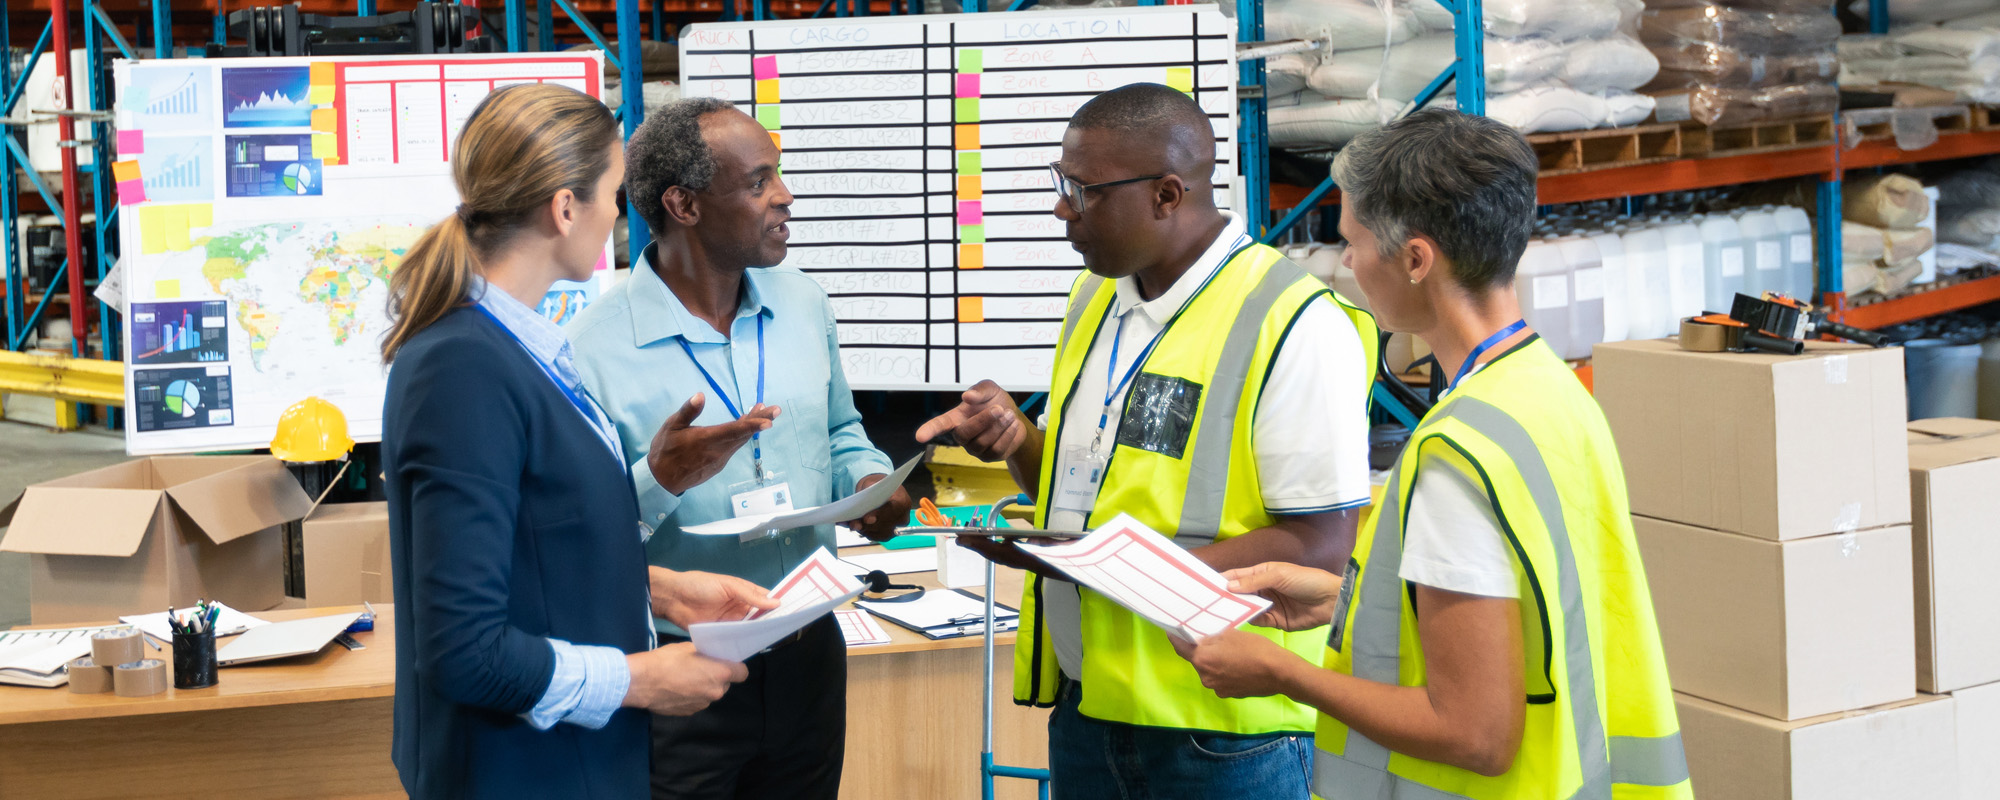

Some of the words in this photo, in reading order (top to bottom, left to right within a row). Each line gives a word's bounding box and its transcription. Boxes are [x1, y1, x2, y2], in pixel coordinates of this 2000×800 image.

[790, 27, 870, 46] CARGO
[1003, 17, 1132, 39] LOCATION
[690, 29, 740, 47] TRUCK
[708, 56, 724, 74] A
[1003, 47, 1057, 64] Zone
[1080, 46, 1098, 65] A
[710, 80, 731, 99] B
[1002, 74, 1051, 90] Zone
[1086, 71, 1104, 89] B
